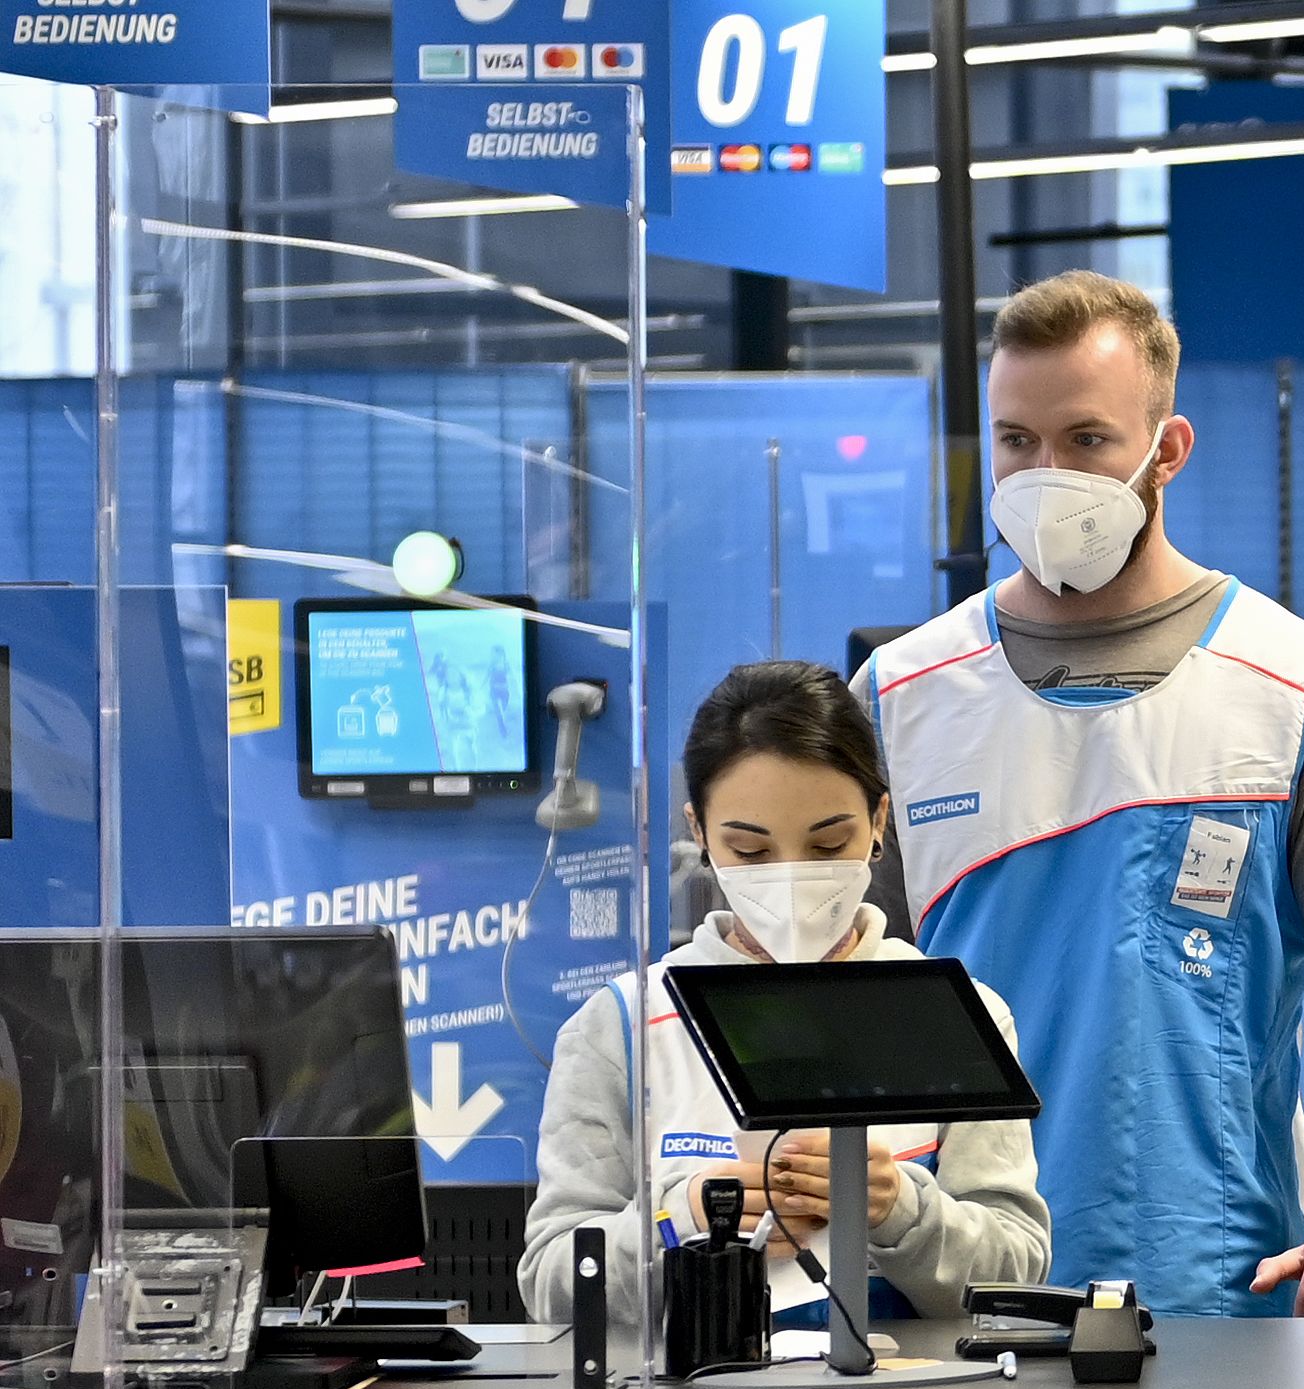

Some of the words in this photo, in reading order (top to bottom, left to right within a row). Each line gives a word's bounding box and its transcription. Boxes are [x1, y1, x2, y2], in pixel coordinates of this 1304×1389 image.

[13, 14, 177, 44] BEDIENUNG
[484, 54, 524, 69] VISA
[697, 13, 828, 128] 01
[467, 132, 598, 158] BEDIENUNG
[229, 656, 264, 684] SB
[911, 798, 975, 820] DECATHLON
[306, 874, 419, 926] DEINE
[394, 899, 529, 960] NFACH
[1180, 960, 1212, 978] 100%
[664, 1138, 737, 1155] DECATHLO
